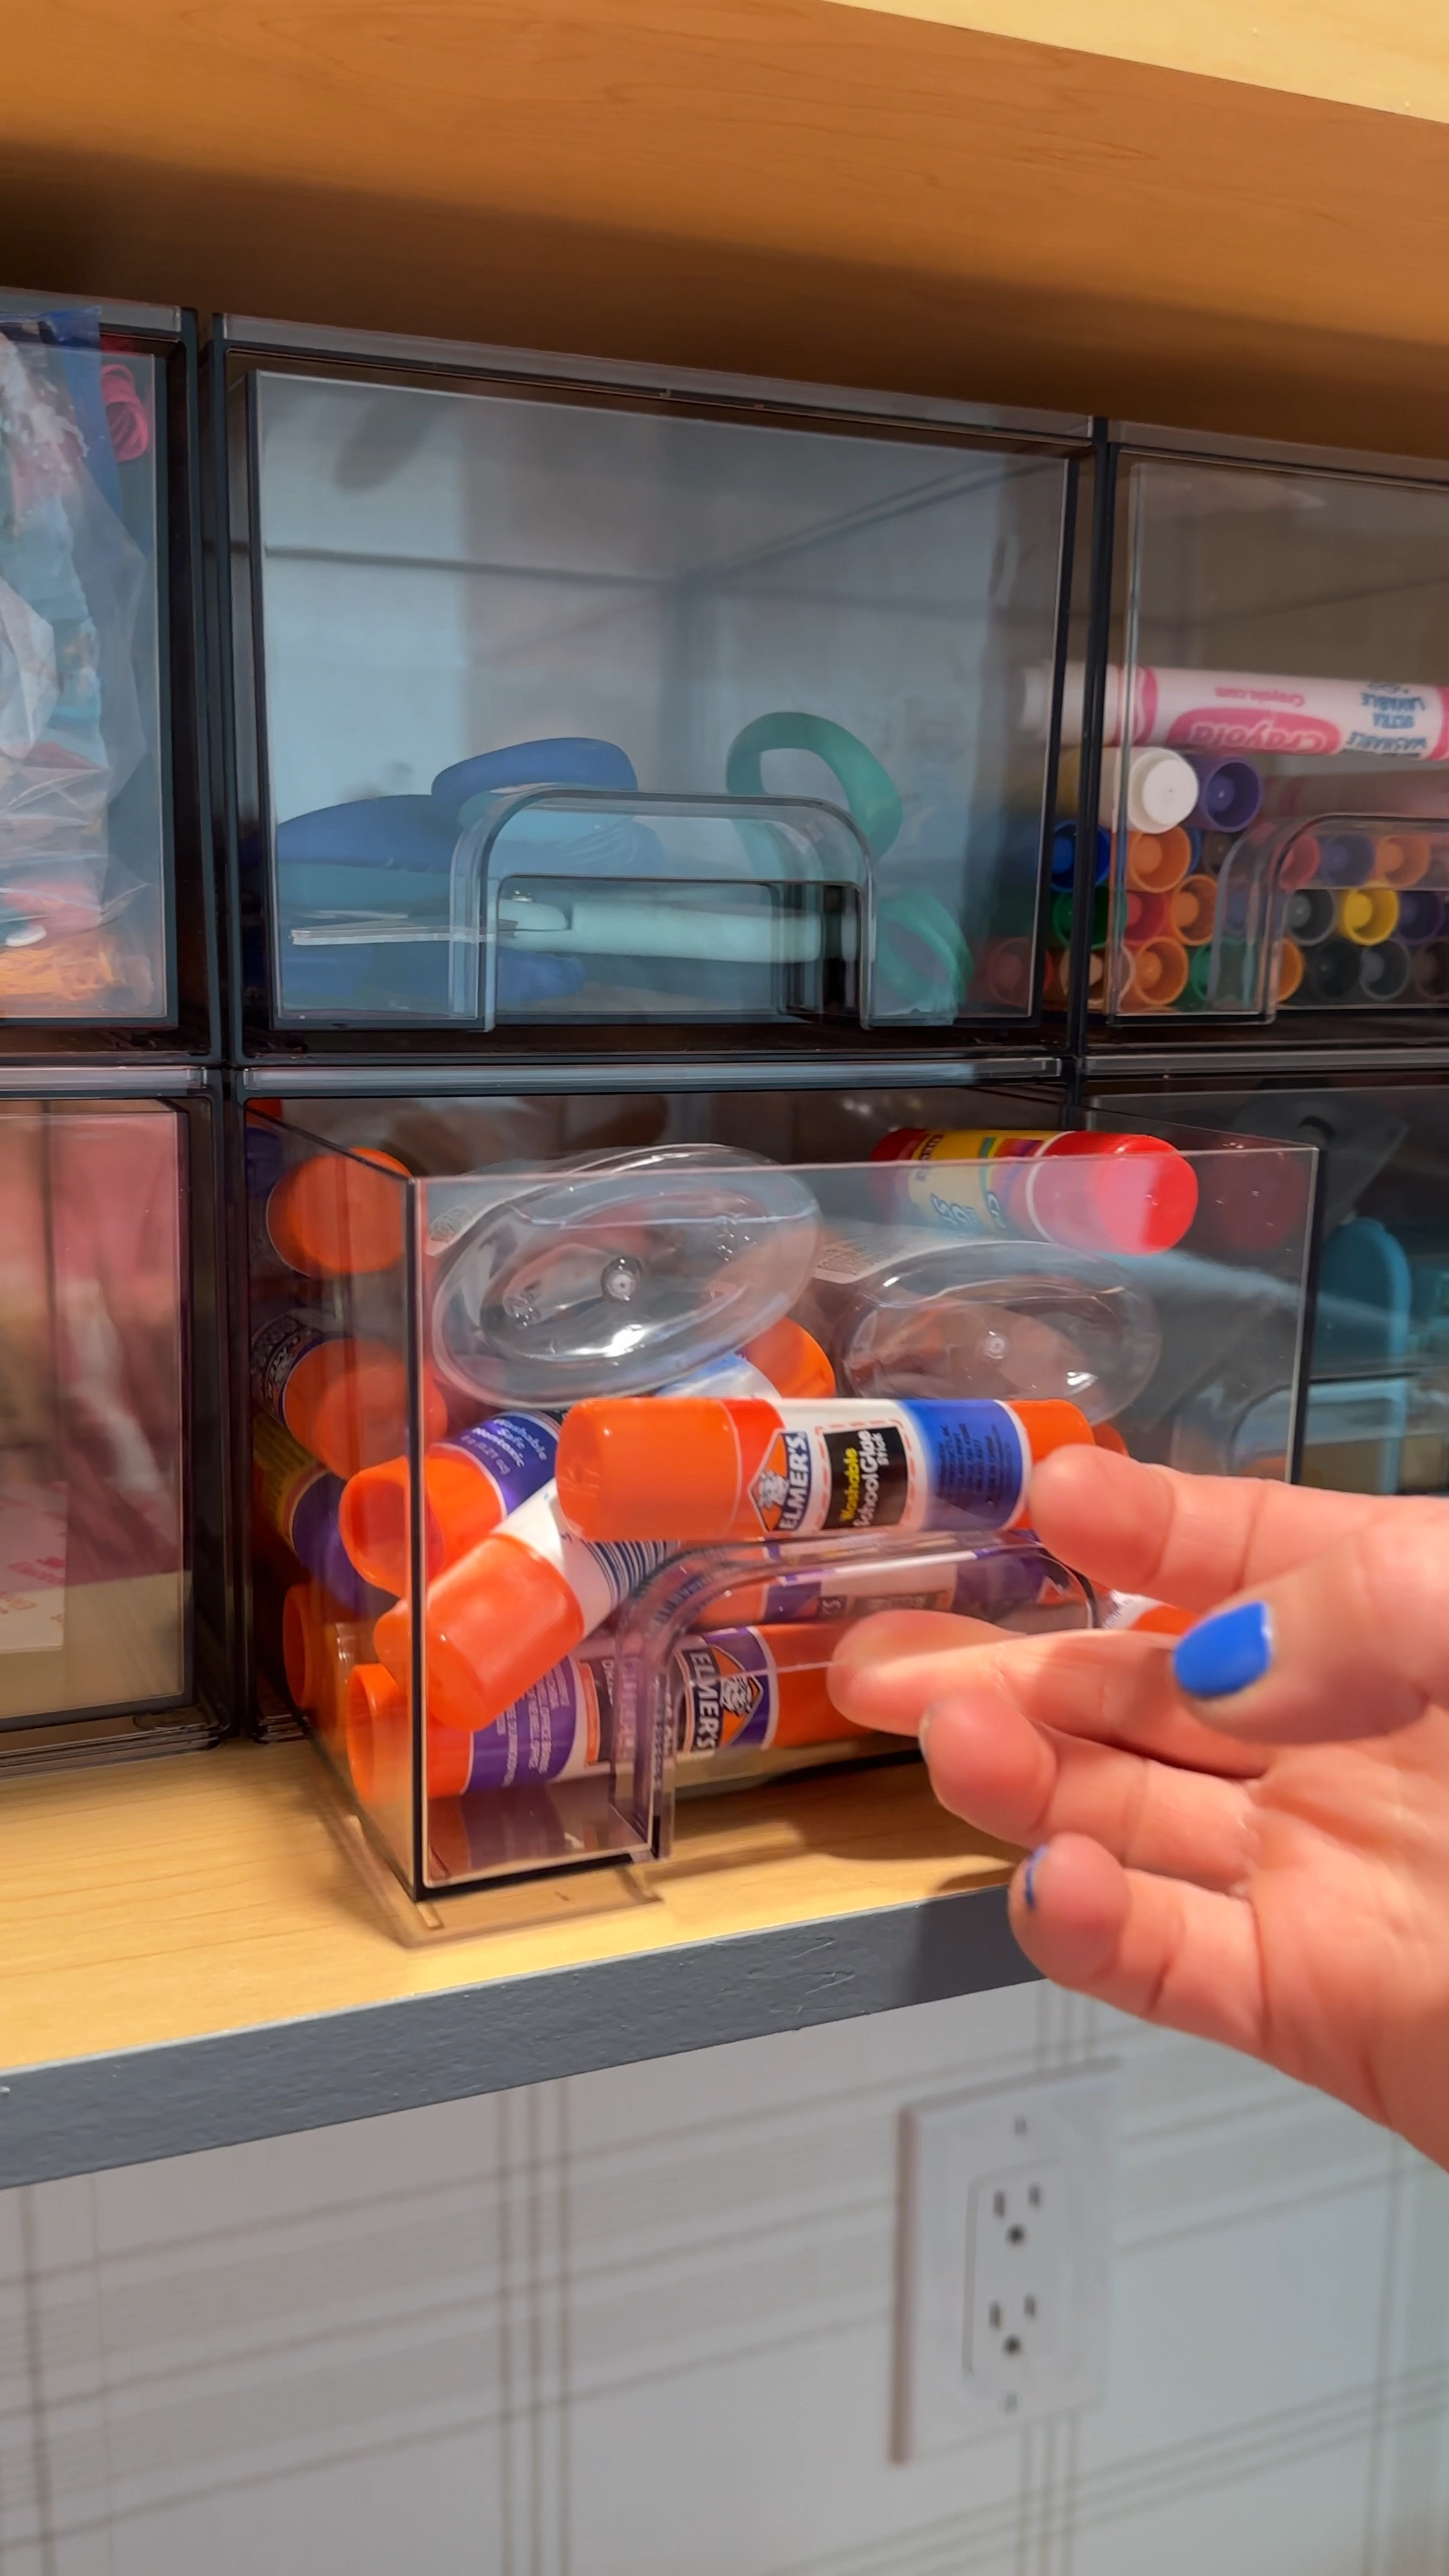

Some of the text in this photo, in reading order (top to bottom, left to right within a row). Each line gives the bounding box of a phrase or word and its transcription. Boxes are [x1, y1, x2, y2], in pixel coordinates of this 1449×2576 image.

[1188, 719, 1328, 752] Crayola
[1373, 712, 1414, 729] ULTRA
[471, 1426, 525, 1468] Nontoxic
[493, 1418, 547, 1460] Washable
[497, 1428, 526, 1450] Safe
[872, 1432, 890, 1466] Stick
[778, 1434, 809, 1529] ELMER'S
[840, 1447, 861, 1523] Washable
[690, 1652, 720, 1750] ELMER'S
